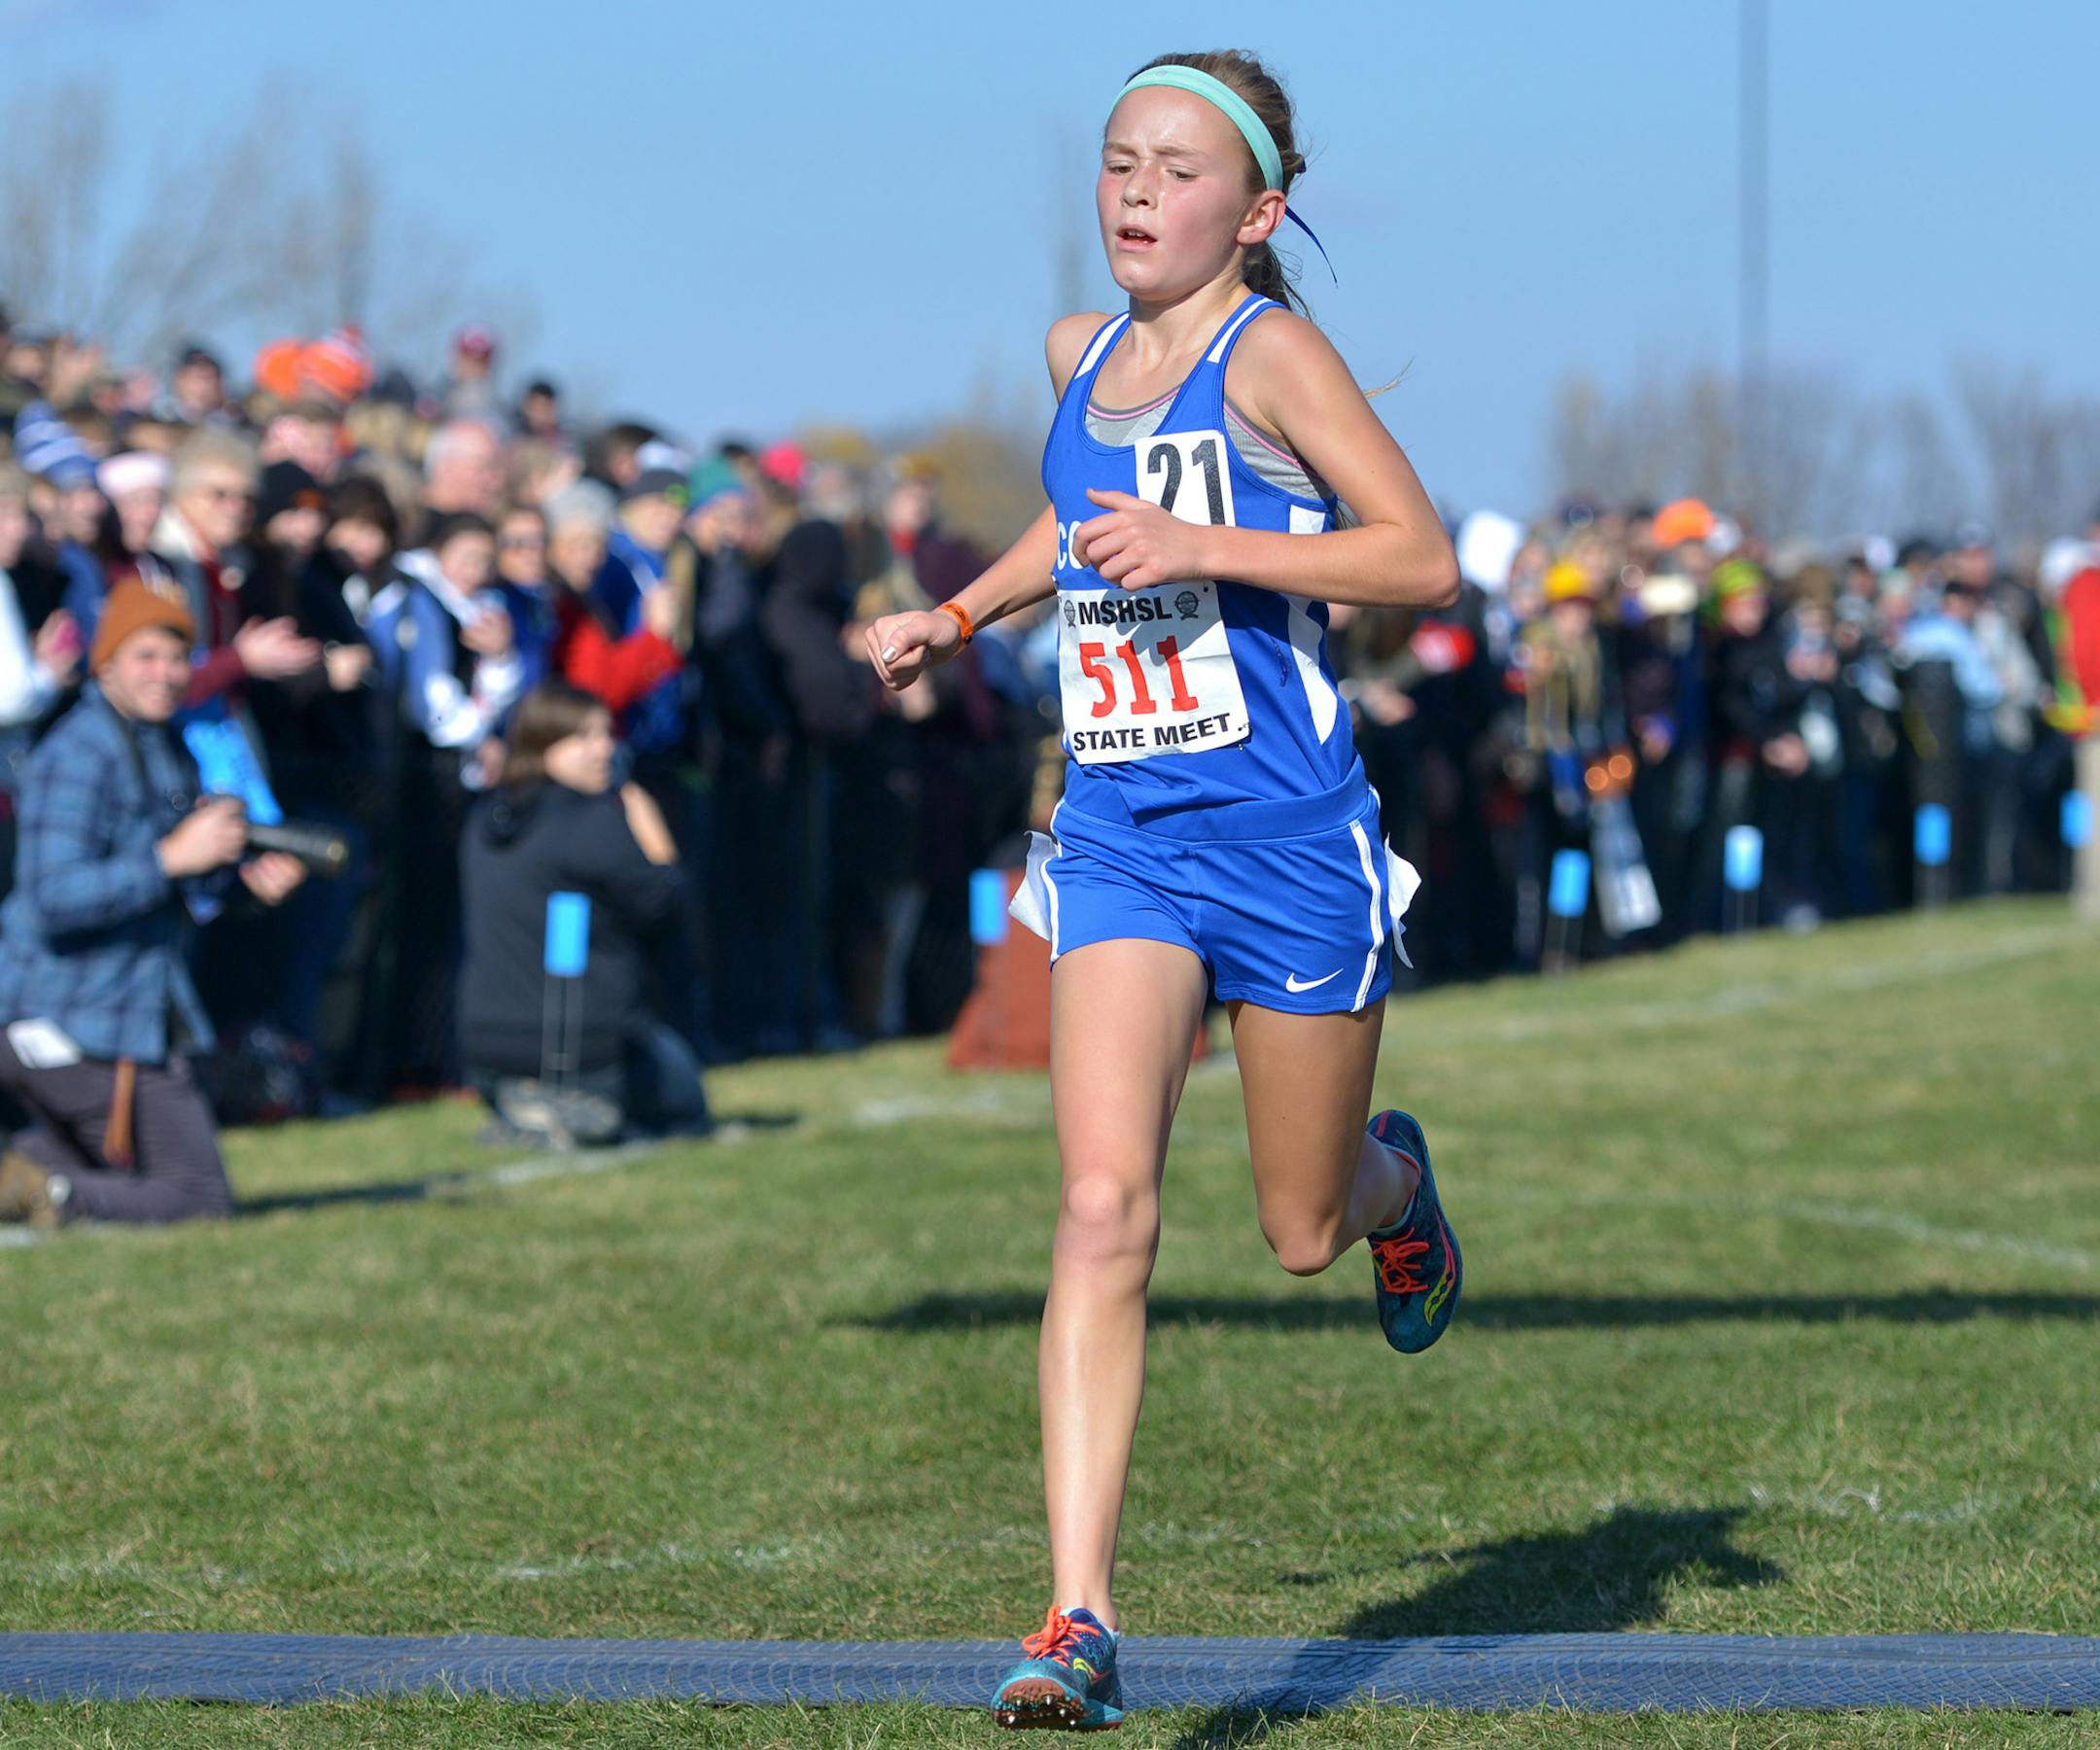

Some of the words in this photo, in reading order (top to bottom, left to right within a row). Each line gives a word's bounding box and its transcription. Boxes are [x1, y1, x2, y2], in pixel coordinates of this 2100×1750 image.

[1147, 438, 1226, 526] 21
[1077, 596, 1173, 626] MSHSL
[1078, 635, 1200, 718] 511
[1072, 727, 1146, 752] STATE
[1154, 712, 1231, 746] MEET
